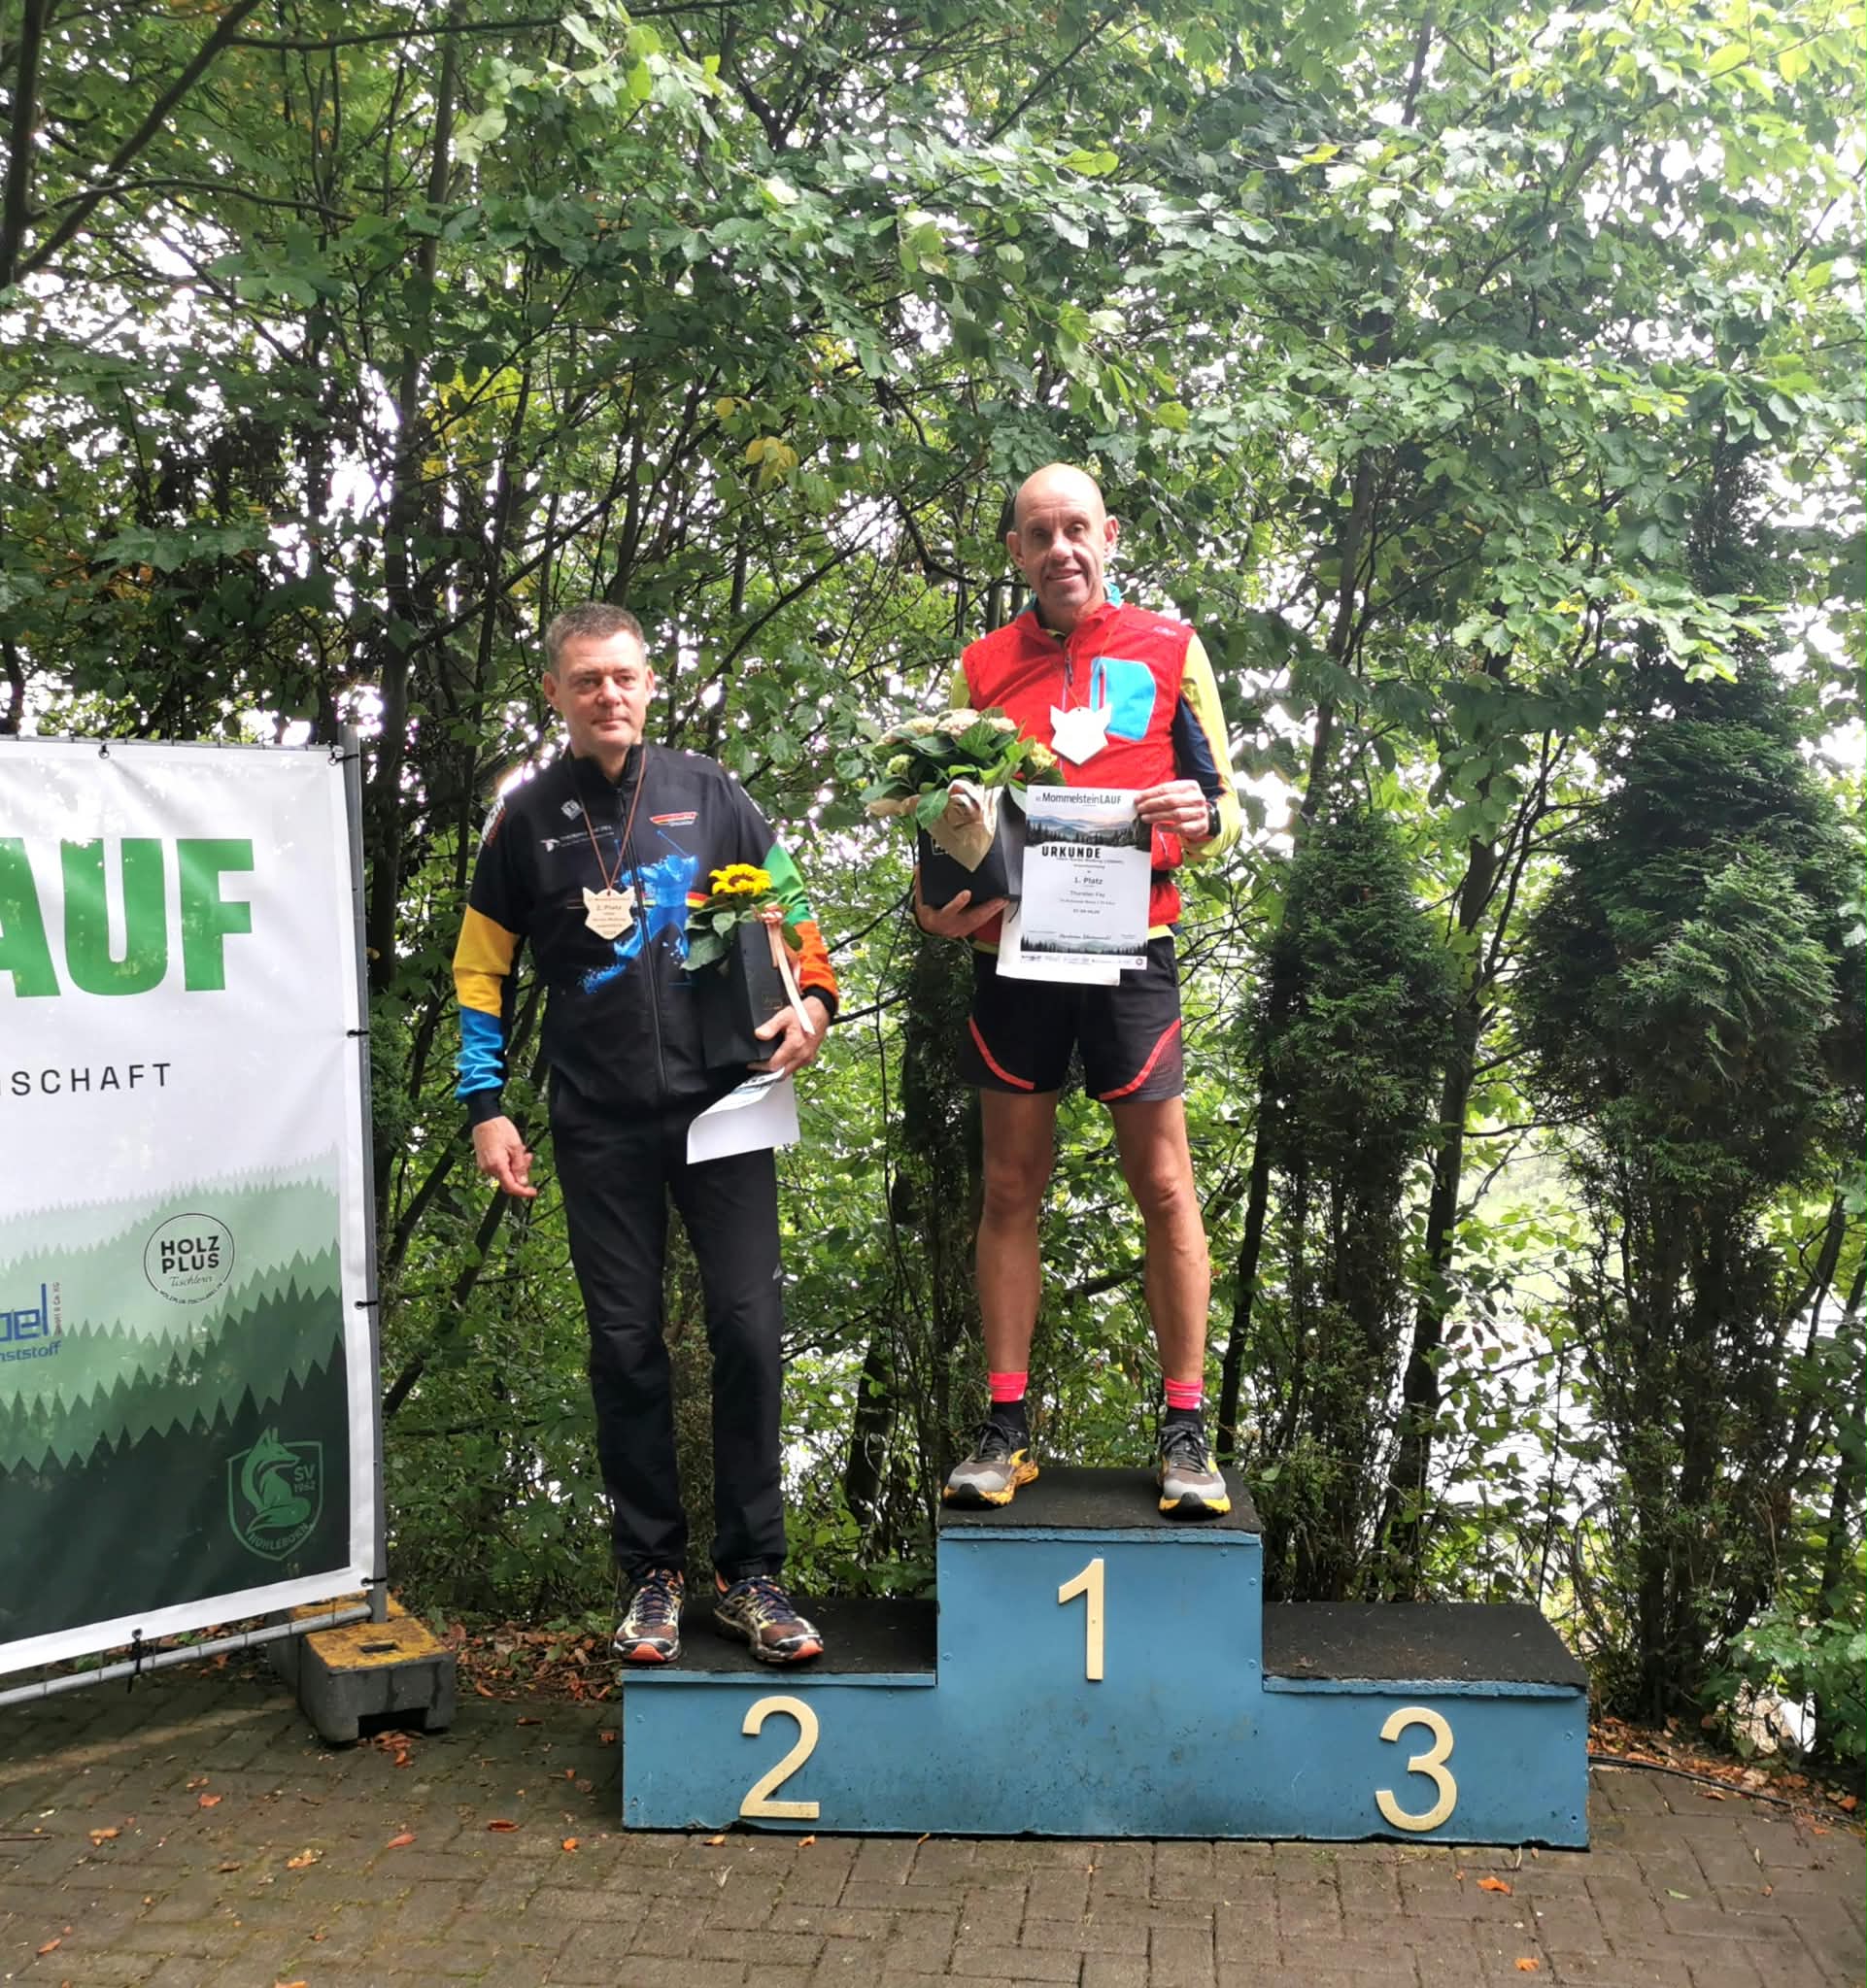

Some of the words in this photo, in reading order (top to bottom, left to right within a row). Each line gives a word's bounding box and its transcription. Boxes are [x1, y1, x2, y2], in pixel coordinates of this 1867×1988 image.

[1042, 792, 1122, 804] MommelsteinLAUF
[1041, 846, 1101, 859] URKUNDE
[0, 1062, 171, 1096] SCHAFT
[161, 1235, 220, 1257] HOLZ
[161, 1253, 220, 1274] PLUS
[293, 1464, 317, 1482] SV
[1057, 1558, 1104, 1681] 1
[740, 1696, 821, 1820] 2
[1374, 1706, 1459, 1832] 3
